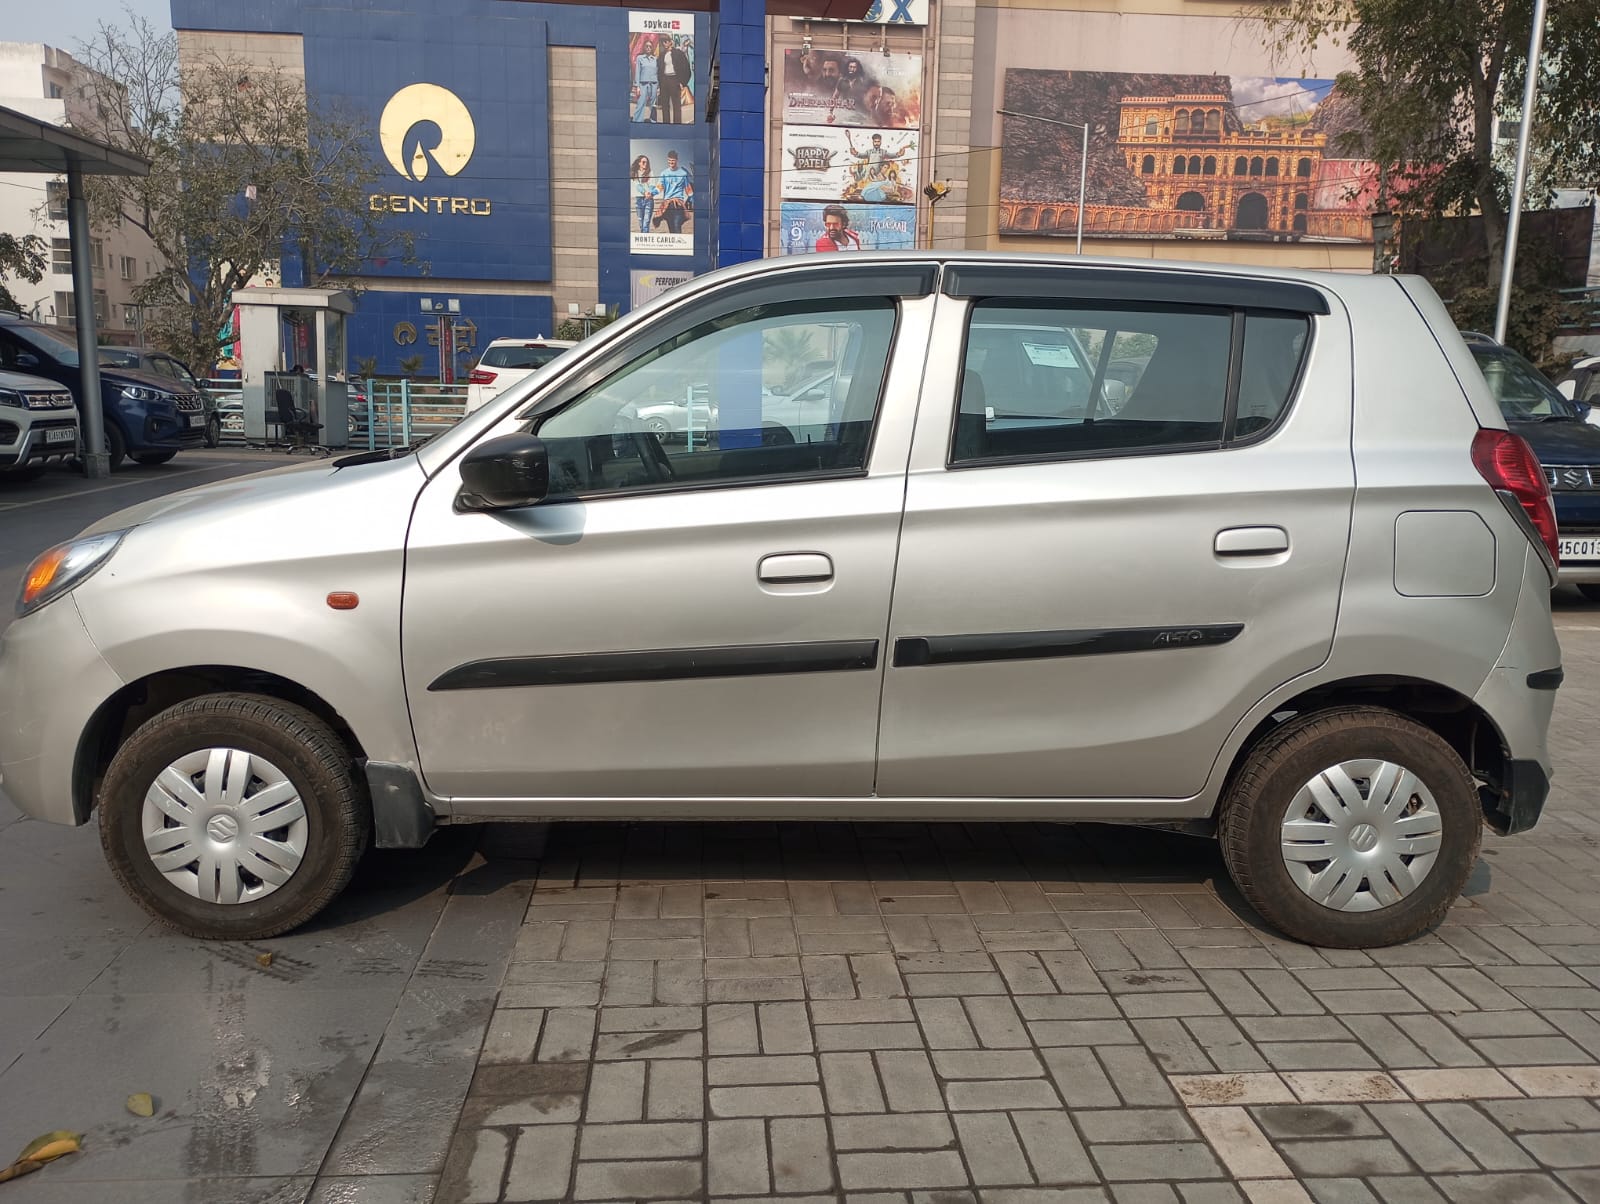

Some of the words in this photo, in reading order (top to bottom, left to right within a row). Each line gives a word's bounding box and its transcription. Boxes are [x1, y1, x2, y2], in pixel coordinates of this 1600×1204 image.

[643, 19, 671, 29] spykar
[796, 147, 829, 160] HAPPY
[798, 158, 826, 169] PATEL
[369, 194, 492, 216] CENTRO
[790, 219, 805, 230] JAN
[791, 226, 802, 241] 9
[656, 236, 676, 244] CARLO
[1152, 629, 1202, 644] ALTO
